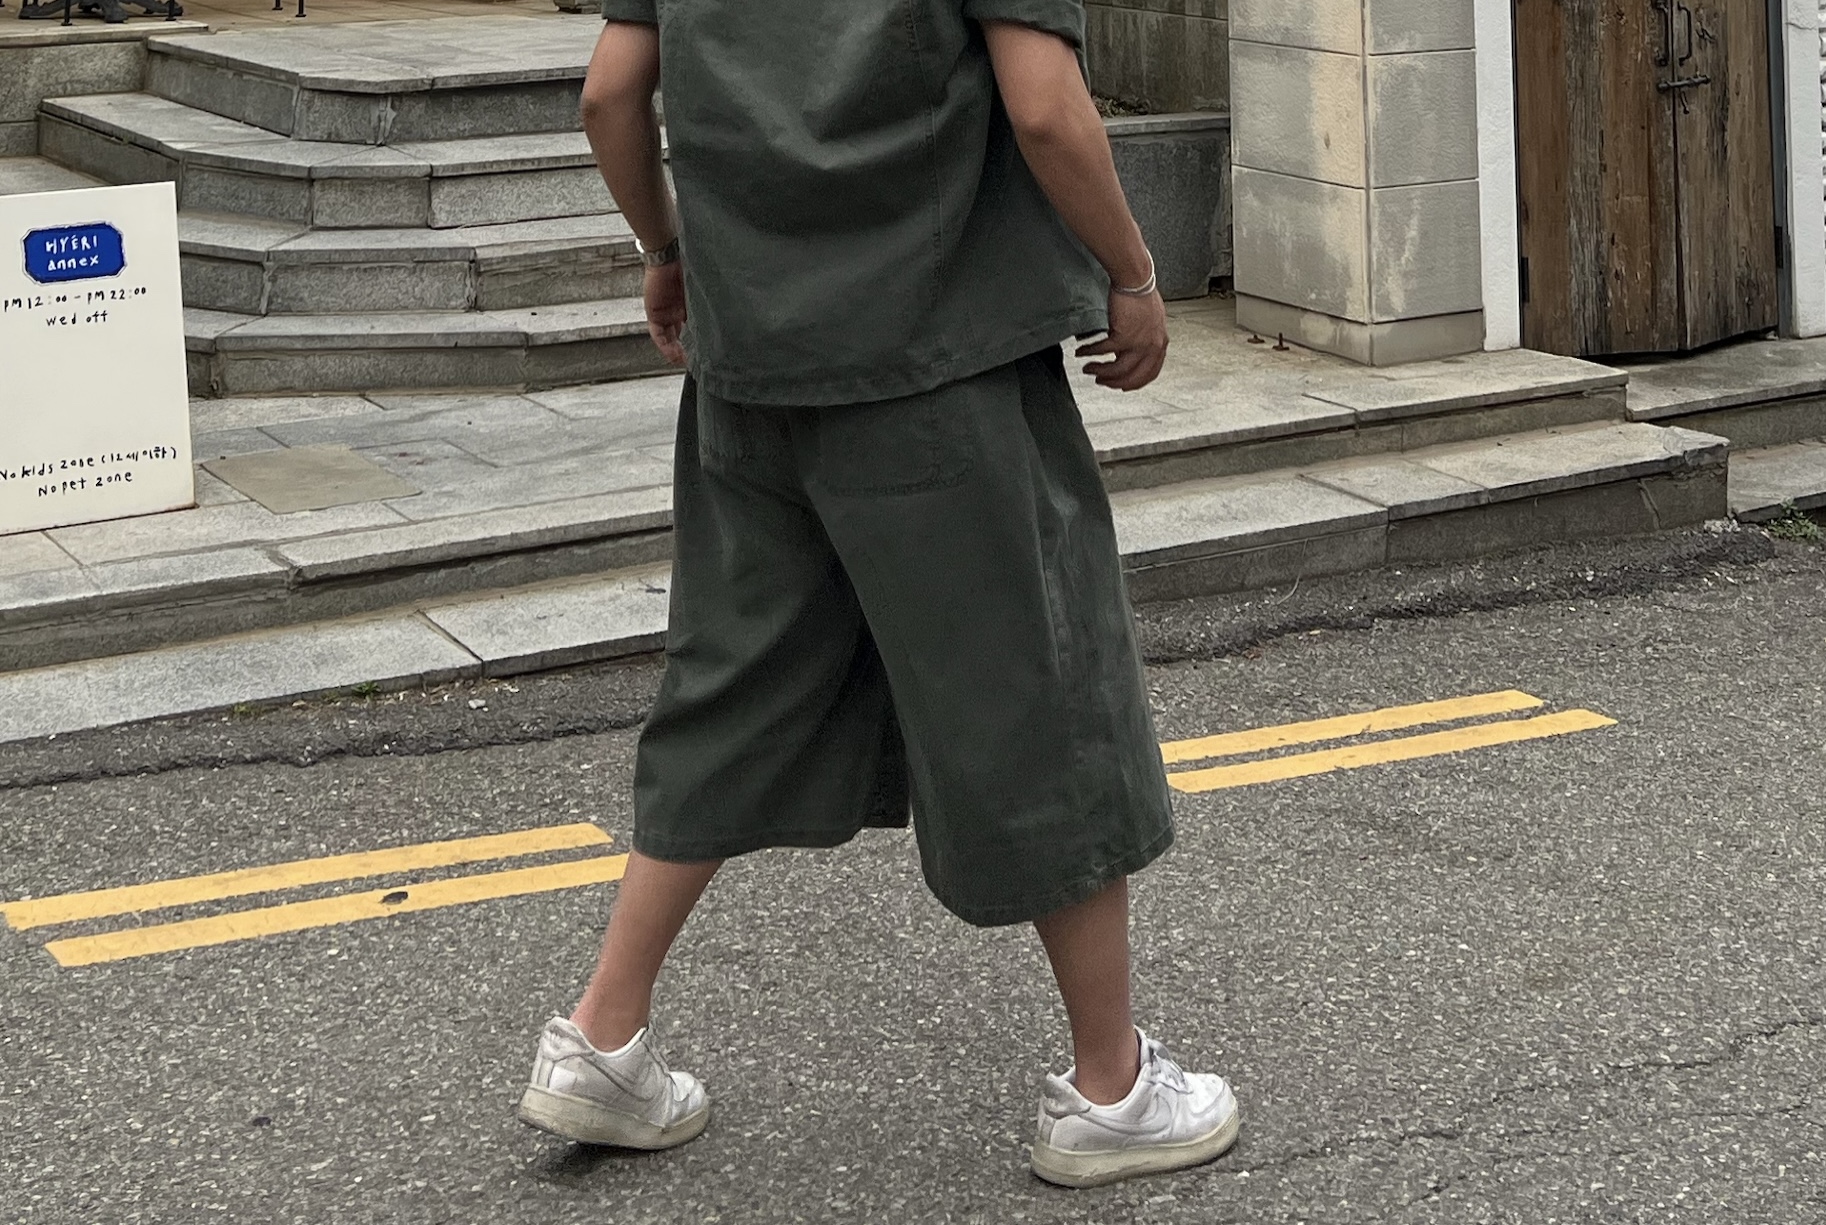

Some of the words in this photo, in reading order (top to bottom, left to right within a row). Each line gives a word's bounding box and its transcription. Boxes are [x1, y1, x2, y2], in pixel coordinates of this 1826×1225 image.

[48, 255, 99, 271] annex
[86, 310, 108, 323] off
[60, 457, 95, 470] zone
[38, 485, 57, 497] No
[62, 478, 87, 496] pet
[95, 471, 133, 487] zone
